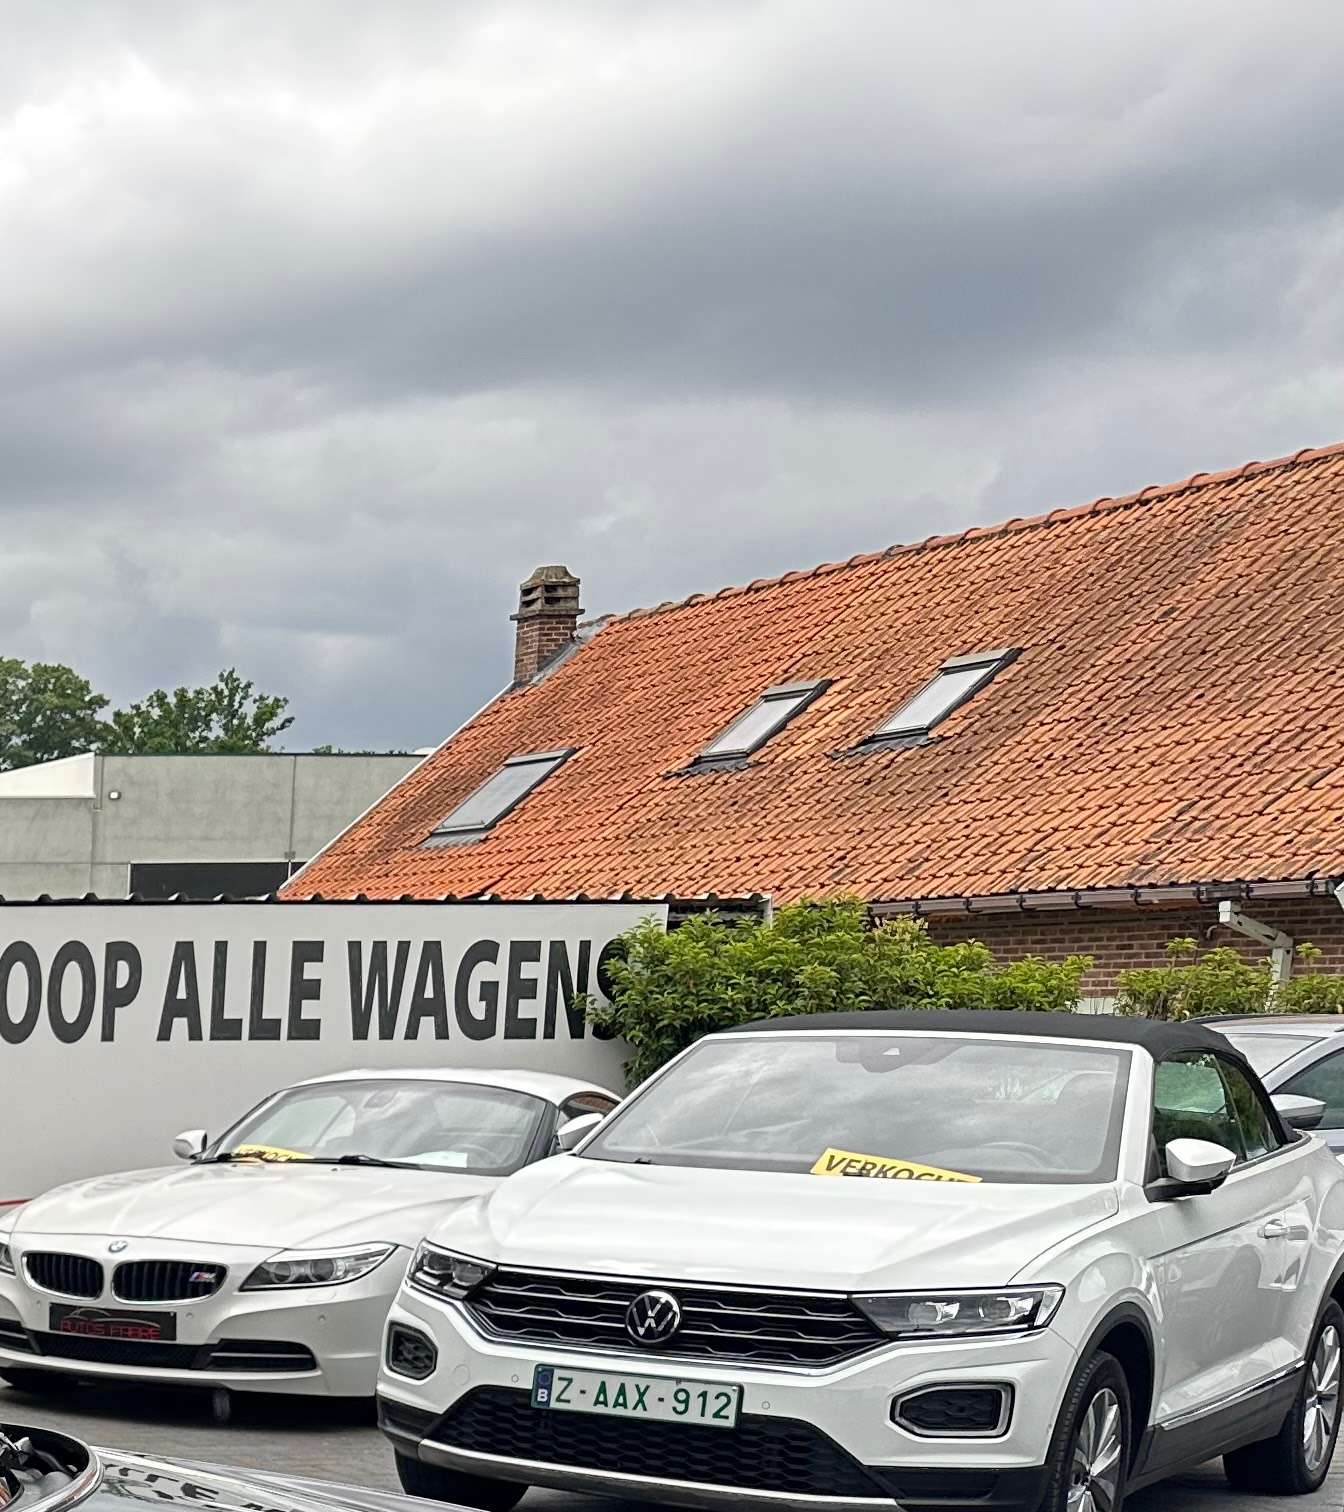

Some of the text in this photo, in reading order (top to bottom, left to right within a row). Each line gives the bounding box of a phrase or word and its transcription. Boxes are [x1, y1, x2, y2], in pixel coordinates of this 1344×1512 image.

[156, 940, 325, 1041] ALLE
[537, 1375, 732, 1420] B Z-AAX-912
